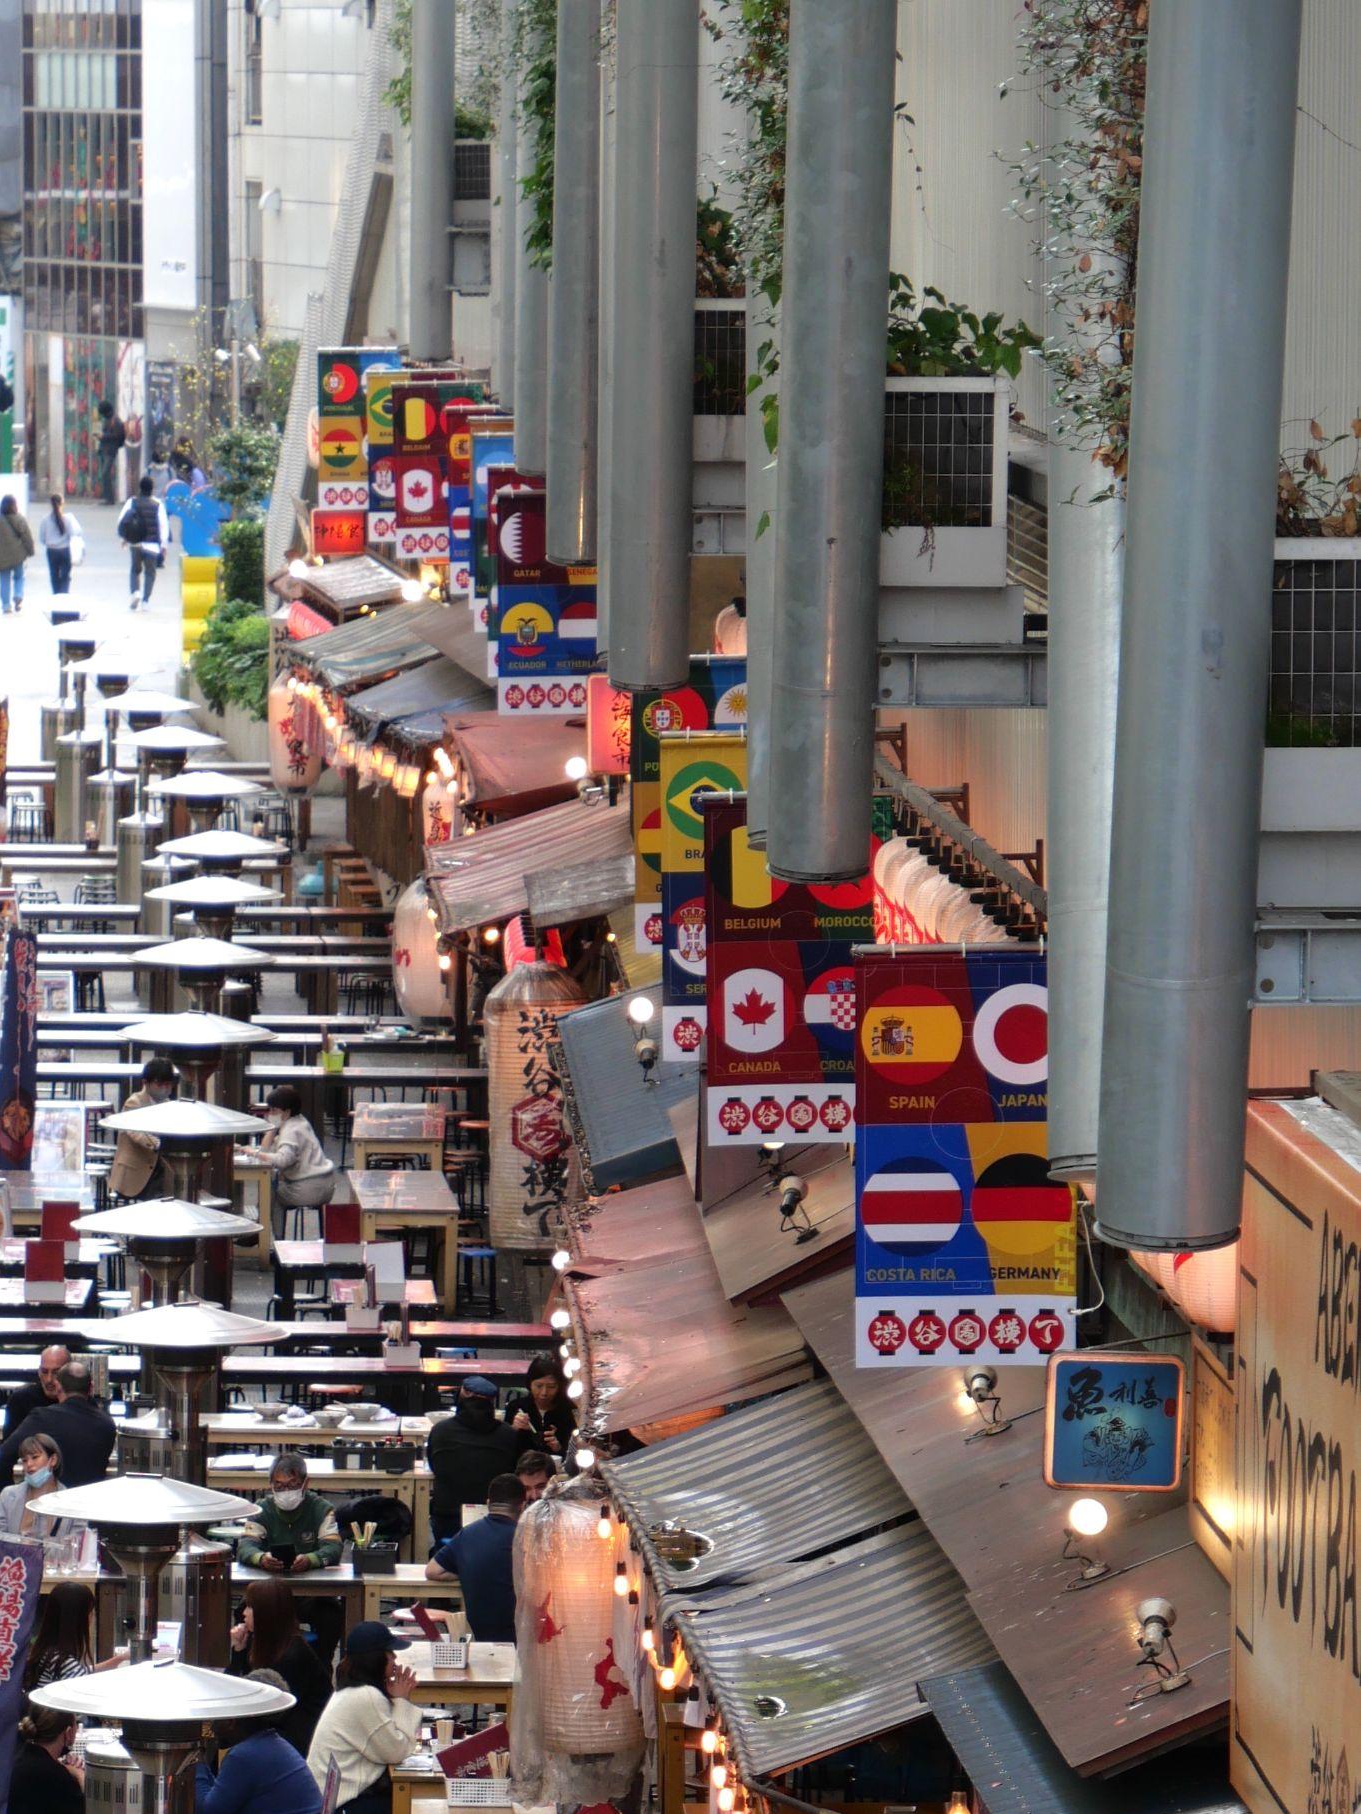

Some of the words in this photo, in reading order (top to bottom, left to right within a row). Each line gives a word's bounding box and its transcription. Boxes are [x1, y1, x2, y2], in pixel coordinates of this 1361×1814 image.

[514, 569, 541, 578] QATAR
[507, 660, 547, 670] ECUADOR
[724, 918, 782, 930] BELGIUM
[729, 1060, 782, 1073] CANADA
[888, 1094, 936, 1110] SPAIN
[866, 1267, 916, 1283] COSTA
[920, 1266, 956, 1282] RICA
[989, 1266, 1061, 1281] GERMANY
